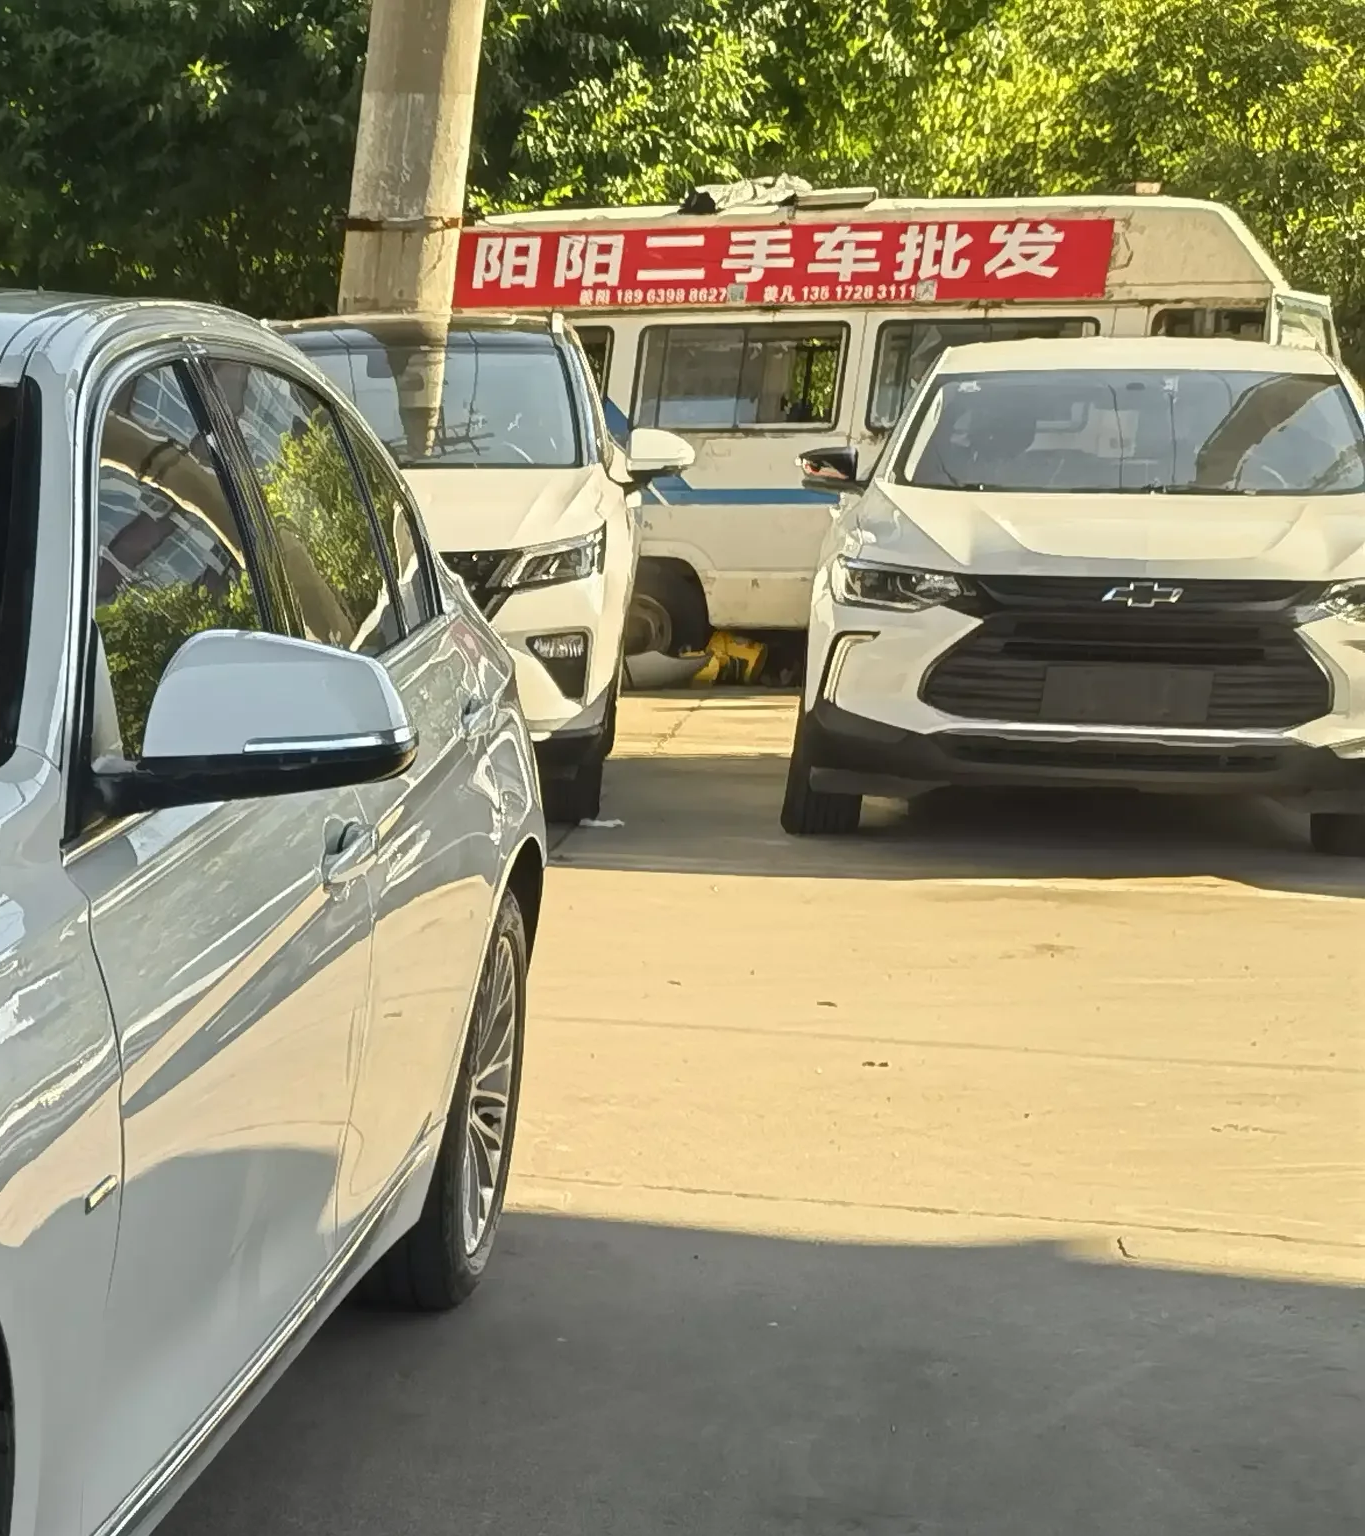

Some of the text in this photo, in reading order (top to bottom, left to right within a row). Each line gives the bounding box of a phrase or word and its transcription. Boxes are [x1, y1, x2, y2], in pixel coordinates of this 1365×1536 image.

[472, 222, 1066, 291] 阳阳二手车批发
[877, 283, 916, 300] 3111
